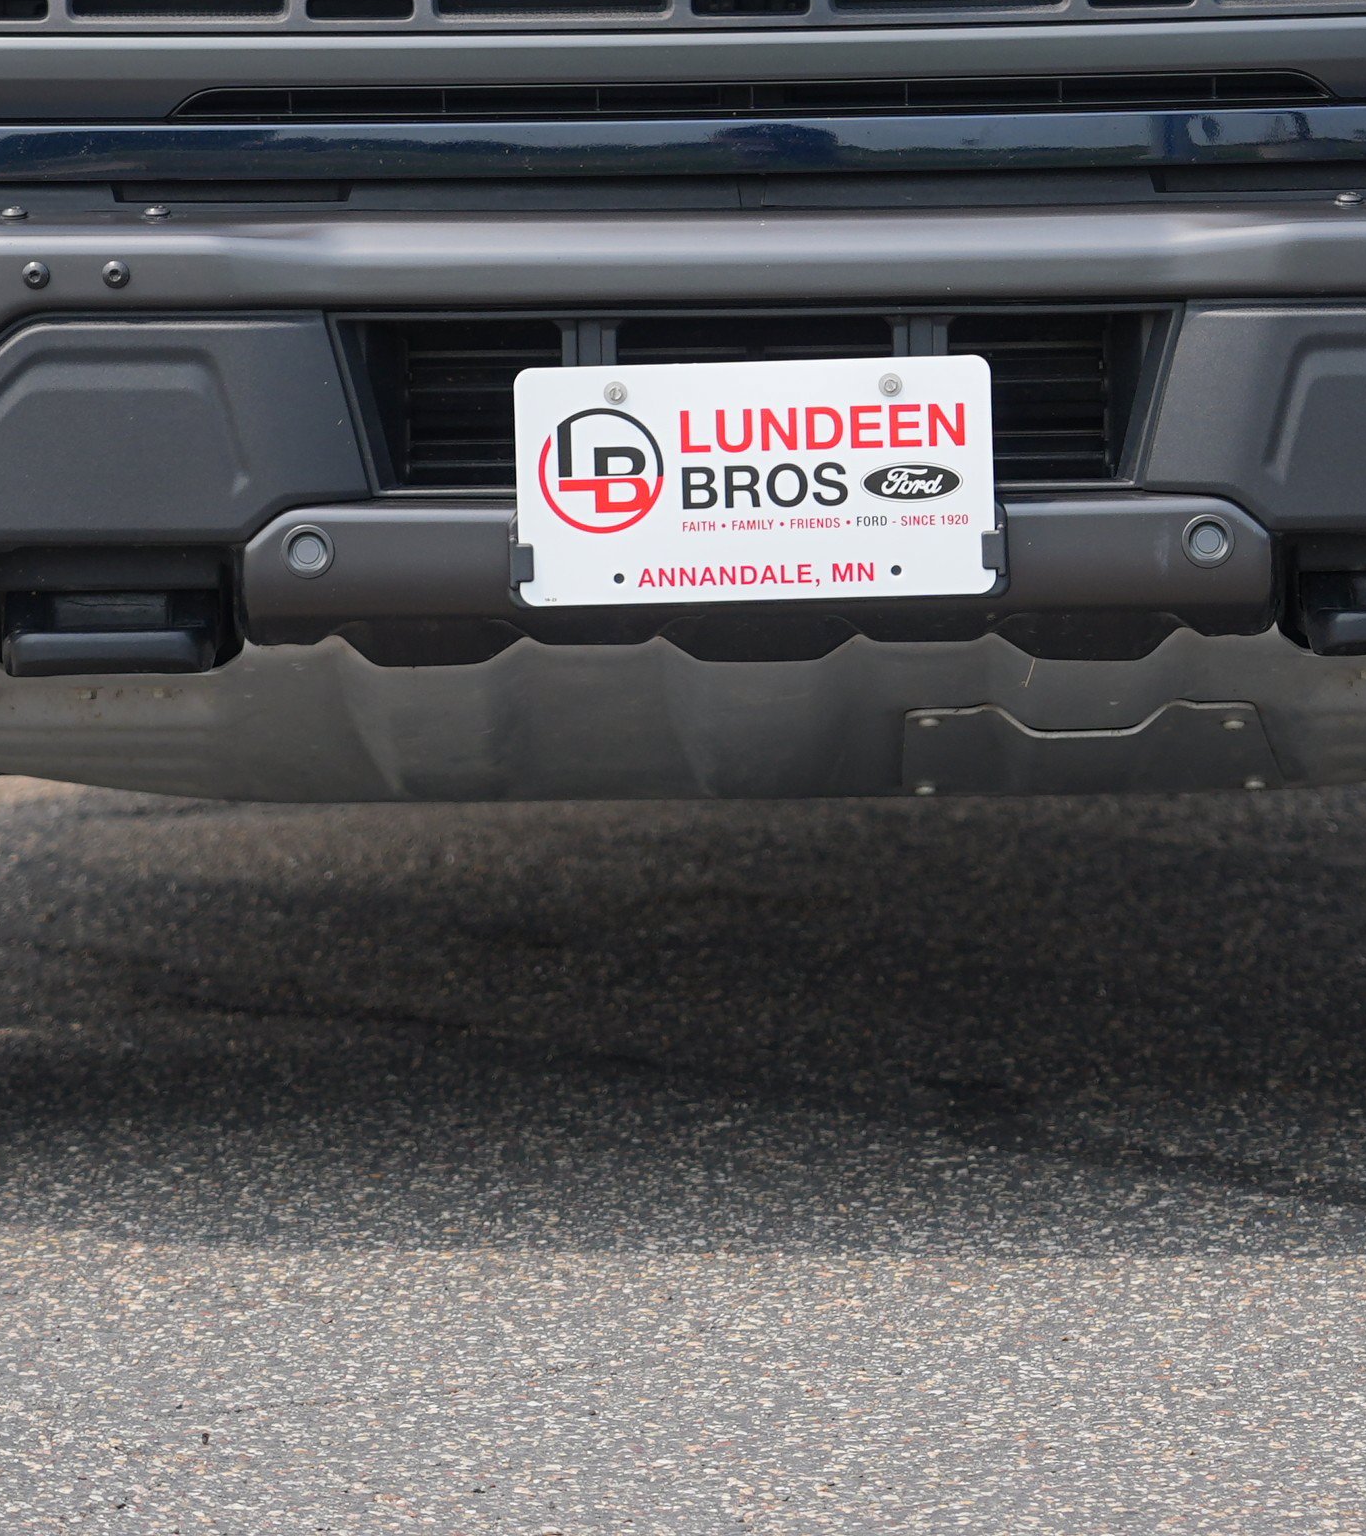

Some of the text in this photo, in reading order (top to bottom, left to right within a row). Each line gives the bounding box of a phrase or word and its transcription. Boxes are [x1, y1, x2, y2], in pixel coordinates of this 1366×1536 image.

[679, 403, 966, 453] LUNDEEN
[681, 462, 848, 510] BROS
[881, 467, 943, 496] Ford
[682, 514, 969, 532] FAITH FAMILY FRIENDS FORD SINCE 1920
[638, 562, 875, 588] ANNANDALE, MN
